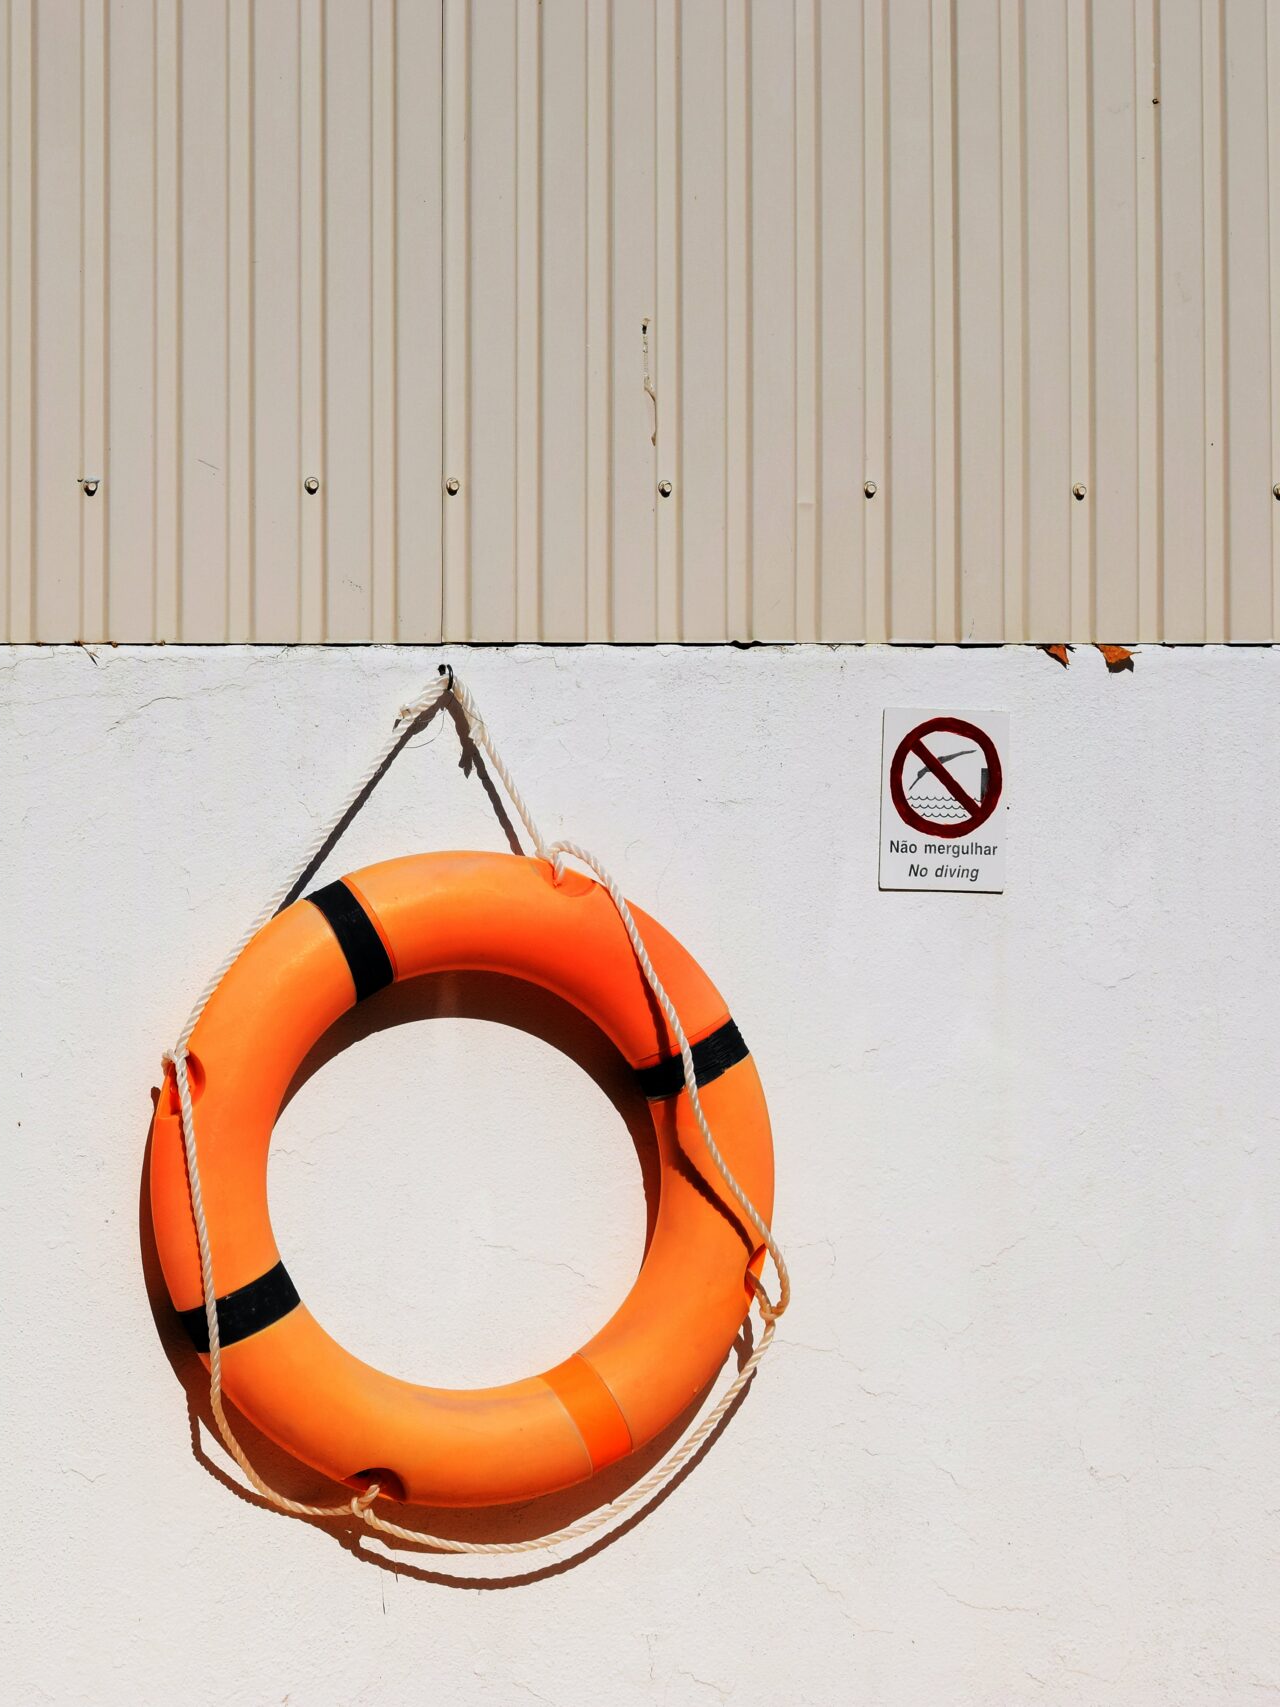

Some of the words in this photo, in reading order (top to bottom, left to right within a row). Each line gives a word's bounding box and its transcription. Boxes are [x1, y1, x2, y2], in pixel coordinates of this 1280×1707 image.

[890, 840, 917, 854] Não
[924, 842, 998, 858] mergulhar
[908, 864, 928, 878] No
[935, 865, 979, 882] diving
